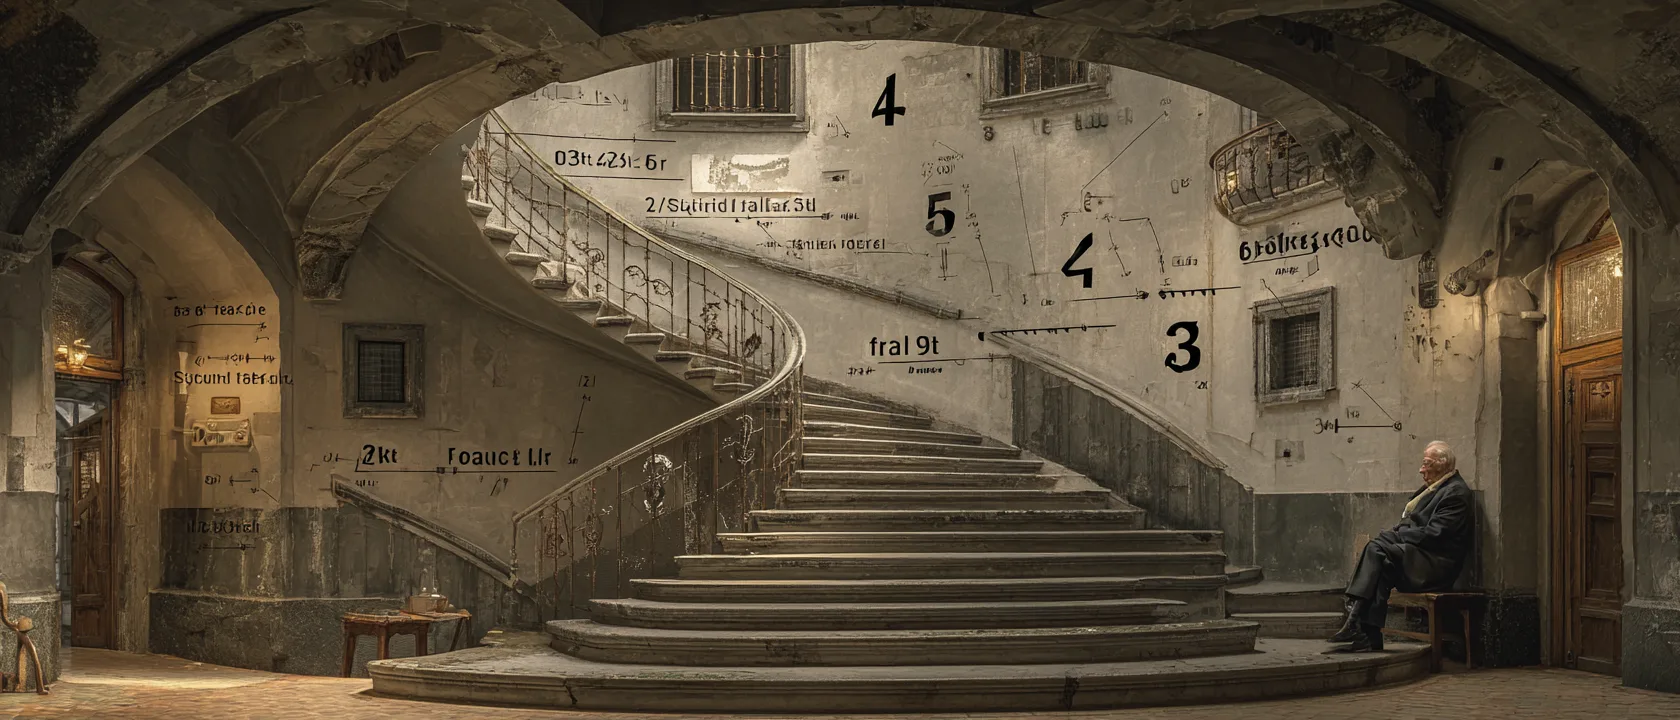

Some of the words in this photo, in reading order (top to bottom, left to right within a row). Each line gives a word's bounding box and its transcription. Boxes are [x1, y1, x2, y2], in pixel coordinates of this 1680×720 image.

[871, 72, 906, 126] 4
[925, 191, 956, 237] 5
[1164, 320, 1201, 373] 3
